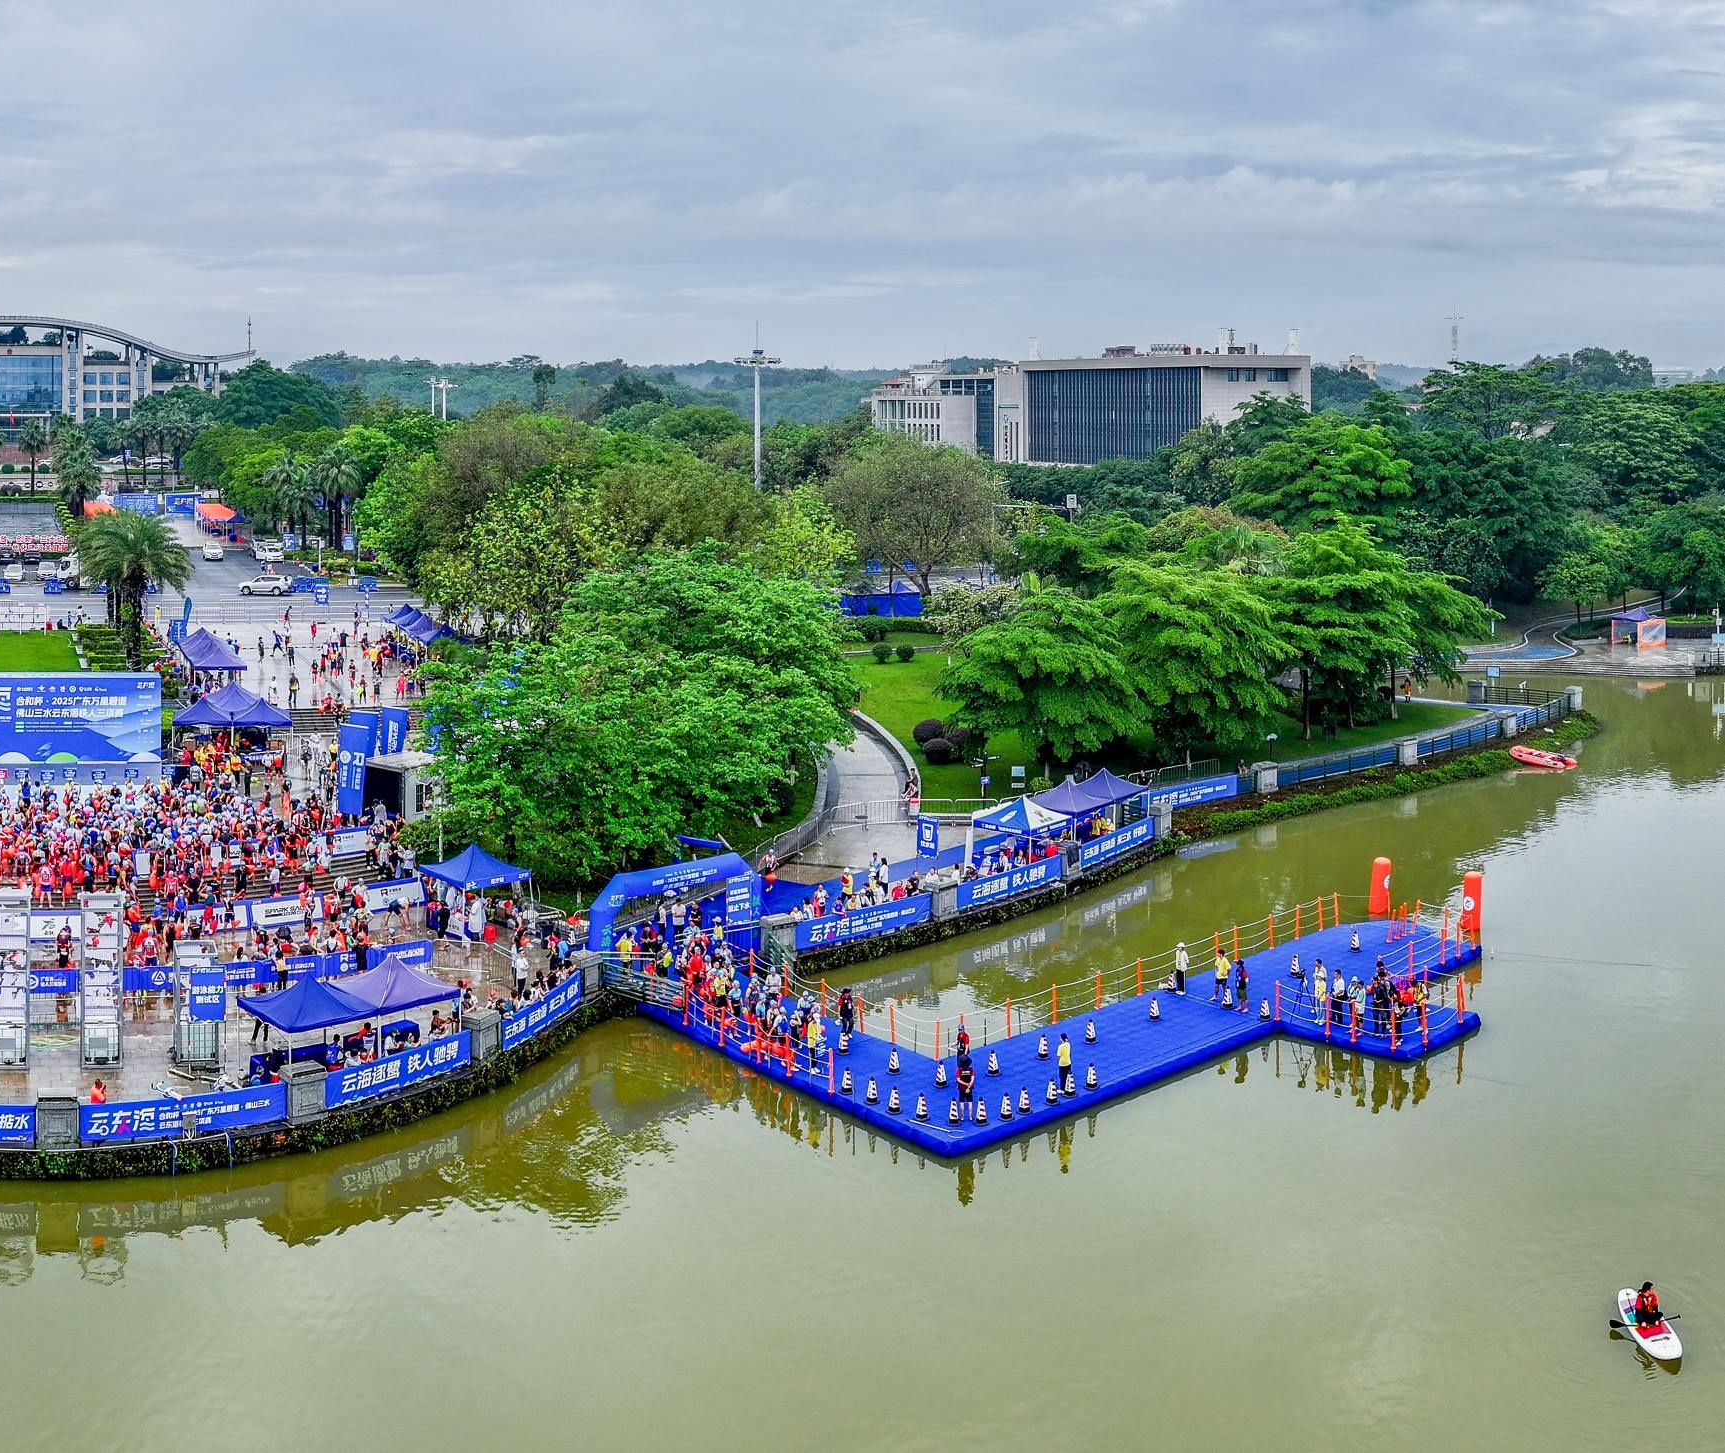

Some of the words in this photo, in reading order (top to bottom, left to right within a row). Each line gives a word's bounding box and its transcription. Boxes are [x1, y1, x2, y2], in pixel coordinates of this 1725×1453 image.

[192, 985, 224, 995] 游泳能力
[196, 995, 220, 1004] 测试区
[342, 1059, 401, 1093] 云海逐鹭
[408, 1041, 459, 1074] 铁人驰骋
[88, 1107, 155, 1136] 云东海
